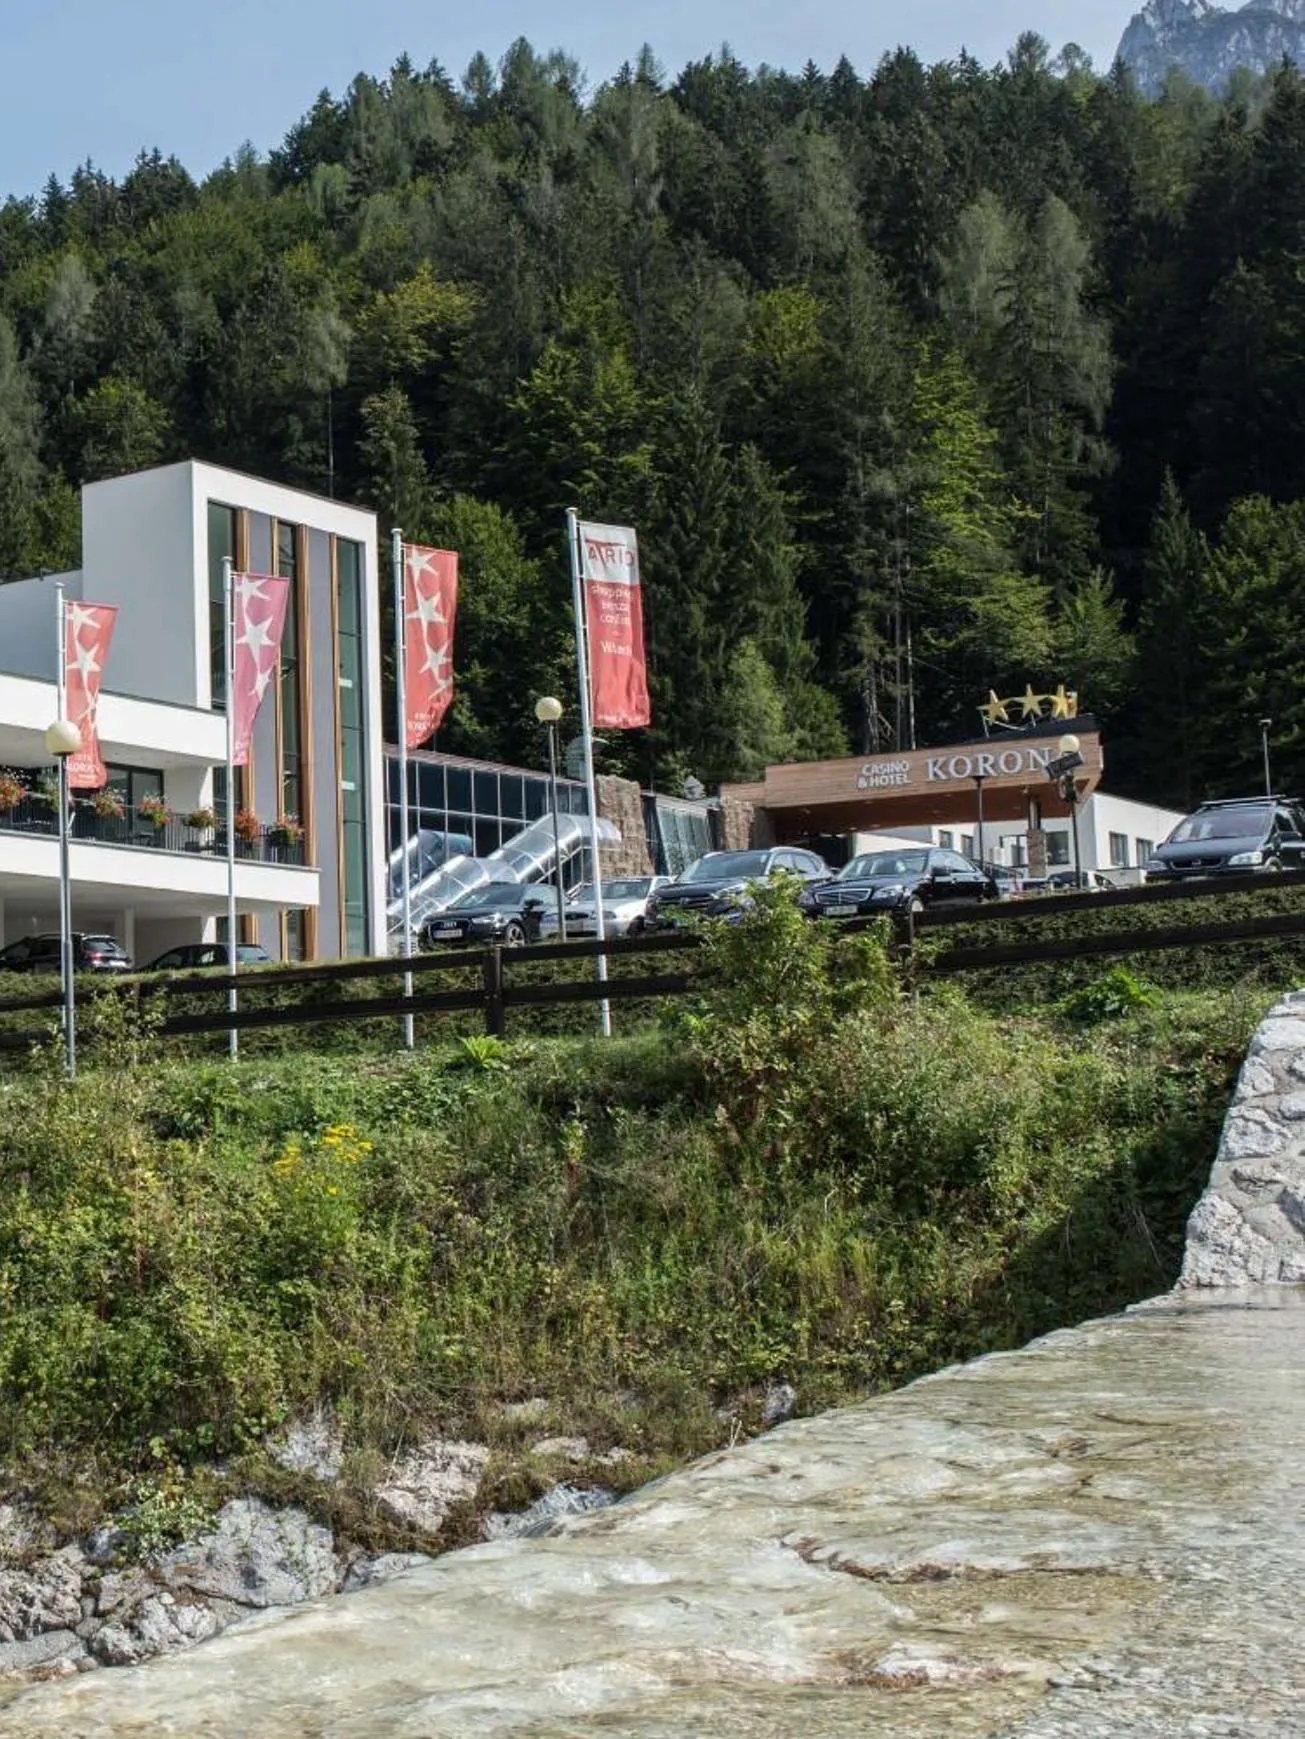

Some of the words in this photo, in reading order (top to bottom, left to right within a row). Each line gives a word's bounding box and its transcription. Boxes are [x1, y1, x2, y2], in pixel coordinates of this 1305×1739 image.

[925, 747, 1055, 782] KORON
[857, 776, 867, 789] &
[869, 773, 912, 787] HOTEL
